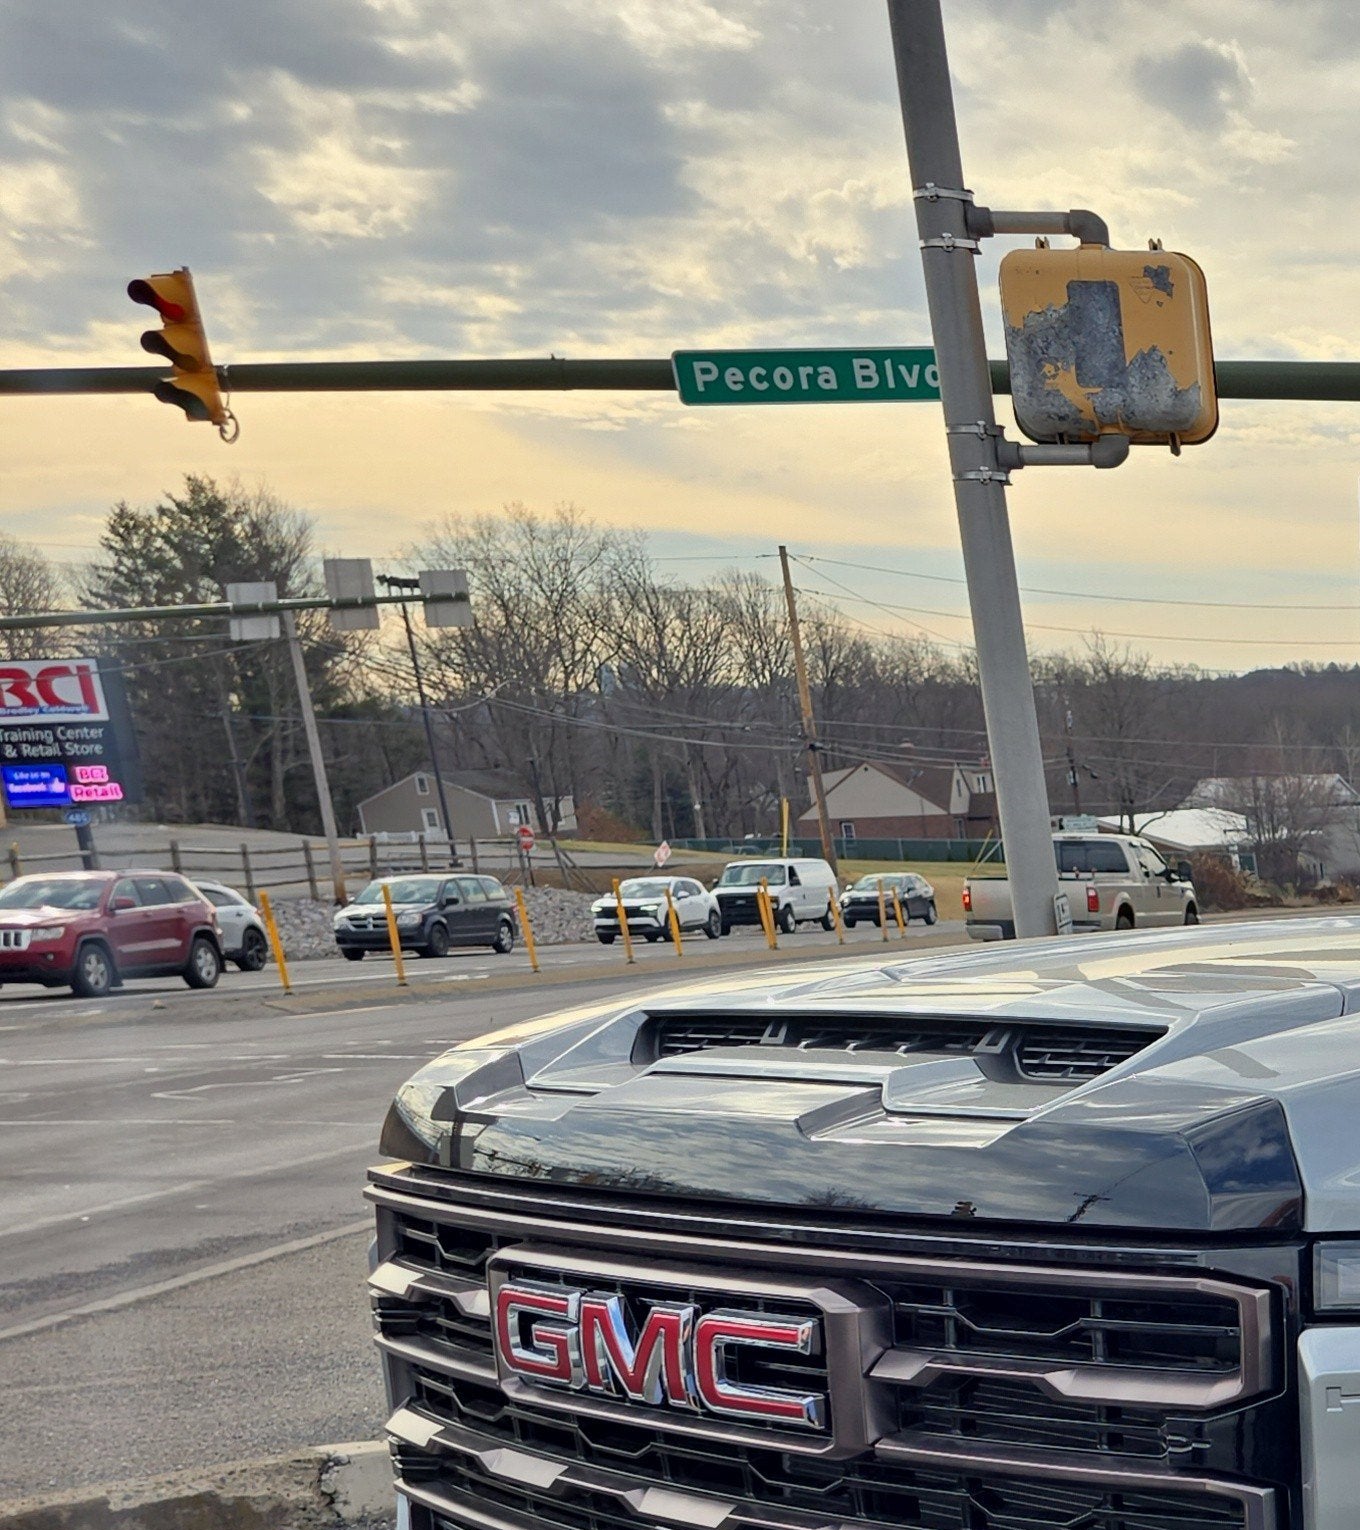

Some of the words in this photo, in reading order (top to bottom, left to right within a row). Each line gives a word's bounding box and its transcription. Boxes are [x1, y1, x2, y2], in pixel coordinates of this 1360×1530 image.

[692, 360, 838, 392] Pecora
[57, 726, 104, 741] Center
[5, 744, 17, 758] &
[22, 742, 61, 758] Retail
[65, 741, 104, 755] Store
[497, 1278, 828, 1431] GMC
